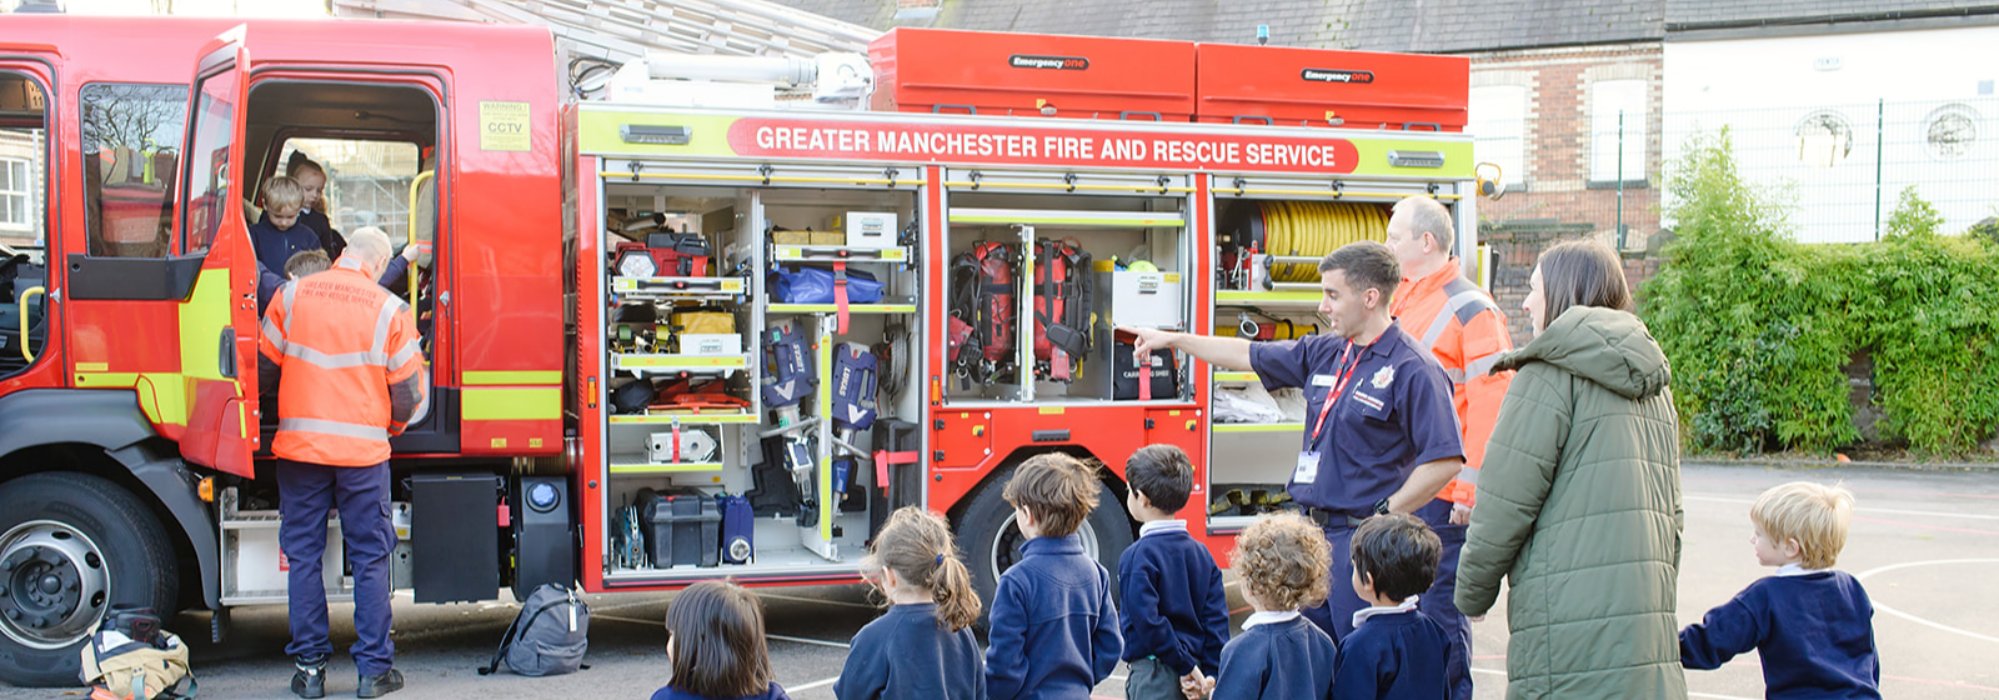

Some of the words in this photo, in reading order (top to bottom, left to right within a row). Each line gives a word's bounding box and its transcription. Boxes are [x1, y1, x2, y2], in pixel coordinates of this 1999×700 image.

[488, 122, 522, 133] CCTV
[756, 126, 870, 152] GREATER
[877, 131, 1038, 158] MANCHESTER
[1043, 136, 1094, 159] FIRE
[1101, 138, 1147, 161] AND
[1153, 140, 1240, 164] RESCUE
[1245, 144, 1335, 166] SERVICE
